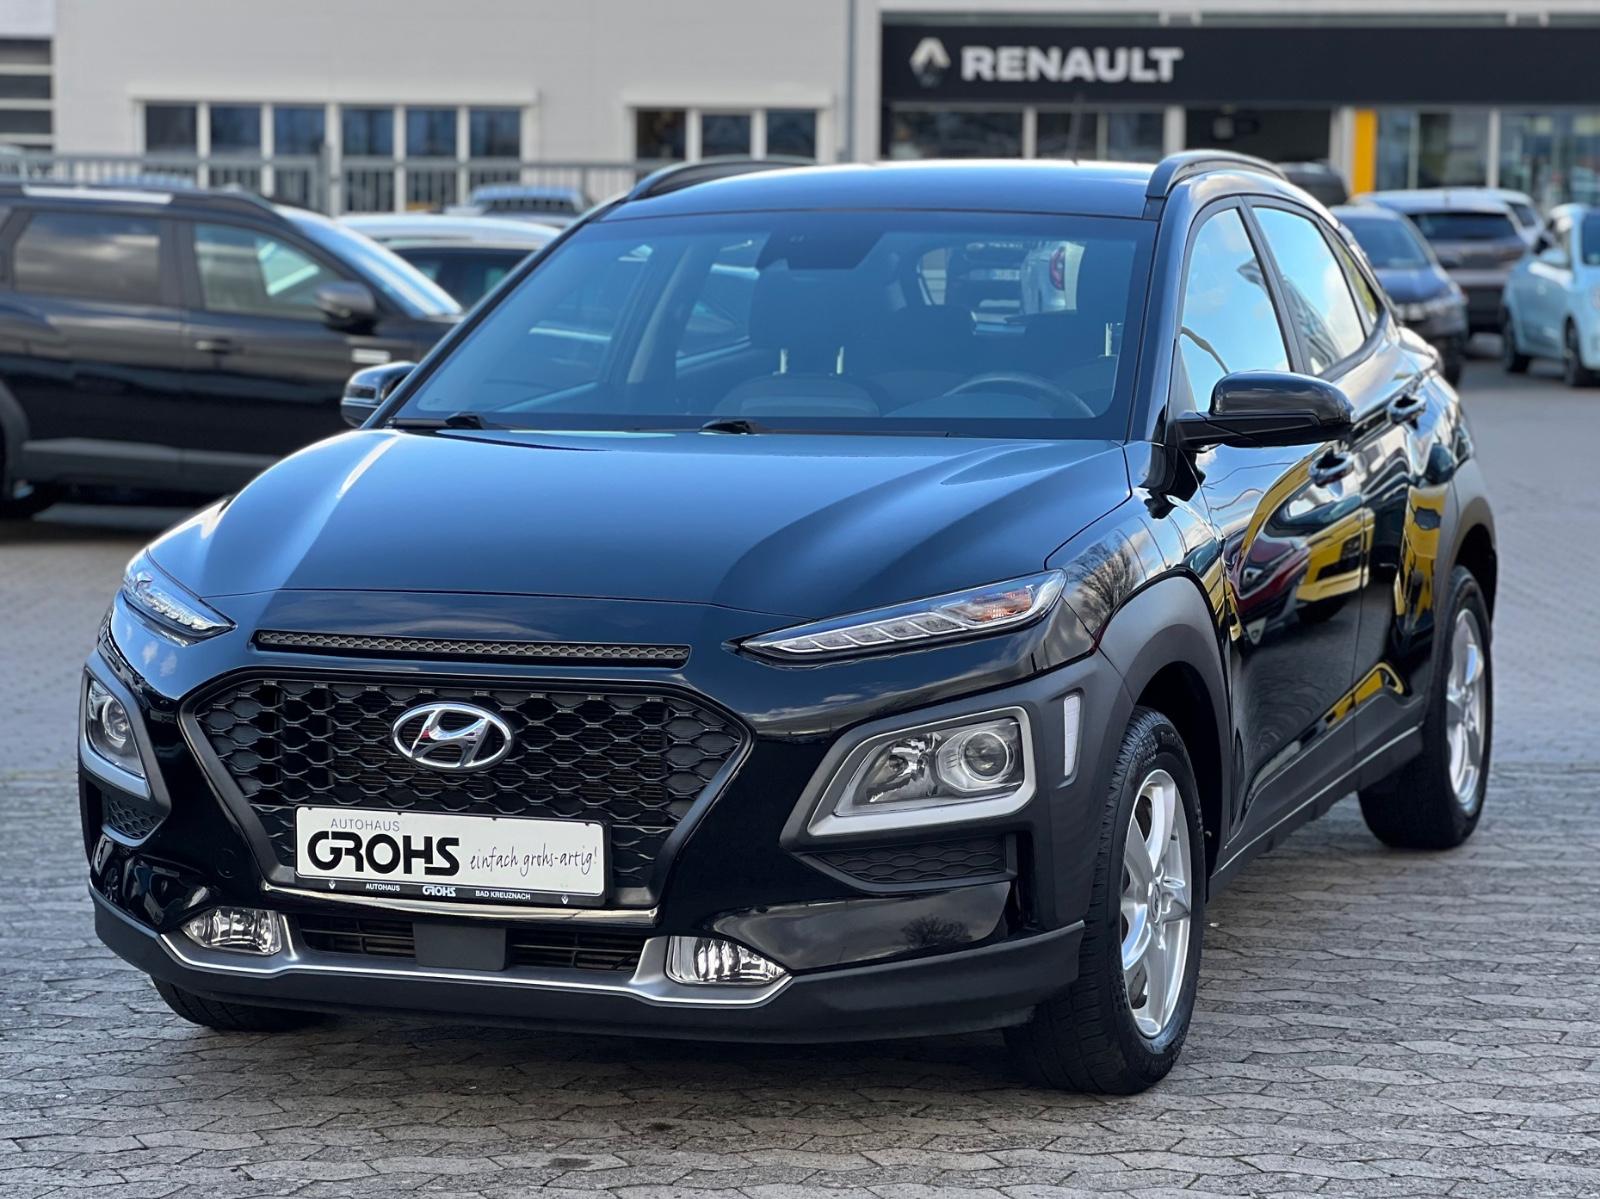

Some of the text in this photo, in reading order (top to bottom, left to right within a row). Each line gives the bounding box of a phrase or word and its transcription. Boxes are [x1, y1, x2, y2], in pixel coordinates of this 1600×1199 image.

[961, 46, 1184, 82] RENAULT
[330, 818, 401, 832] AUTOHAUS
[307, 830, 460, 876] GROHS
[470, 843, 598, 877] einfach grohs-artig!
[365, 883, 401, 892] AUTOHAUS
[422, 885, 457, 897] GROHS
[490, 891, 531, 900] KREUZNACH
